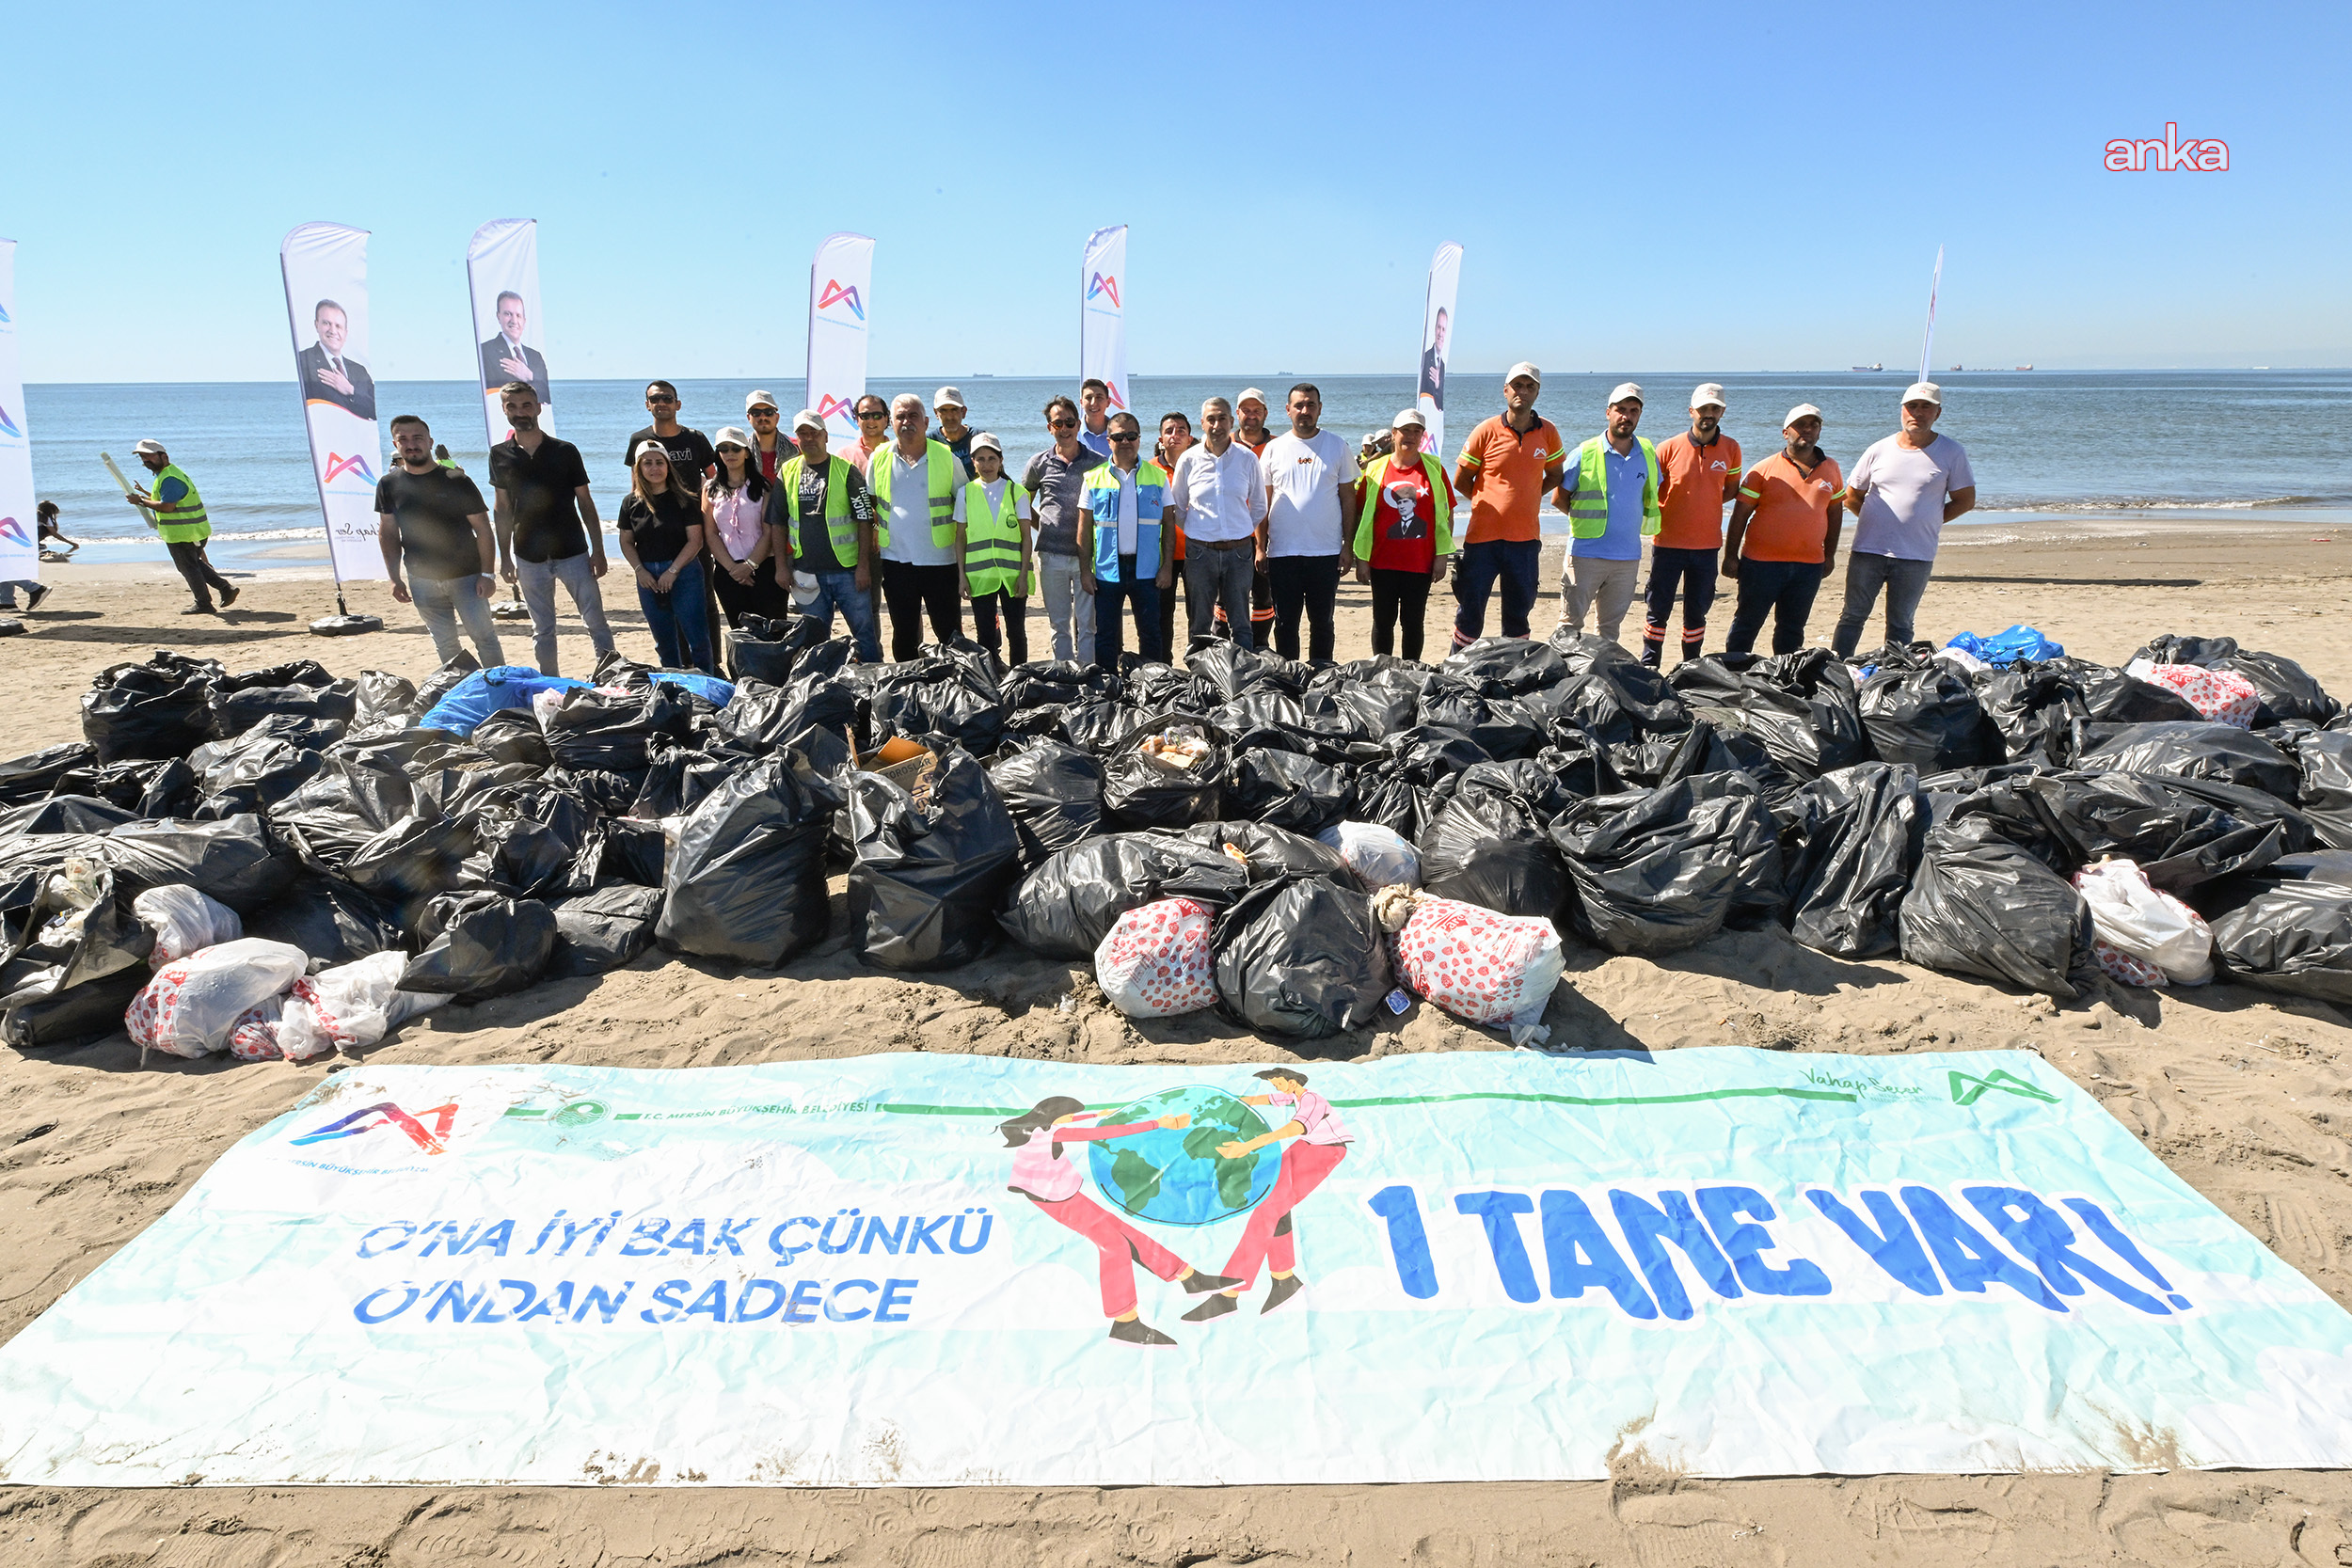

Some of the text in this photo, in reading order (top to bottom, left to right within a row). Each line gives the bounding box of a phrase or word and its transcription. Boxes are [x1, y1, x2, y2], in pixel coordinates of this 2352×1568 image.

[850, 495, 867, 520] BACK
[885, 758, 932, 780] TOROSLAR
[1799, 1068, 1867, 1099] Vahap
[666, 1109, 716, 1119] MERSİN
[355, 1208, 993, 1267] O'NA İYİ BAK ÇÜNKÜ
[1367, 1185, 2193, 1320] 1 TANE VAR!
[353, 1278, 919, 1323] O'NDAN SADECE
